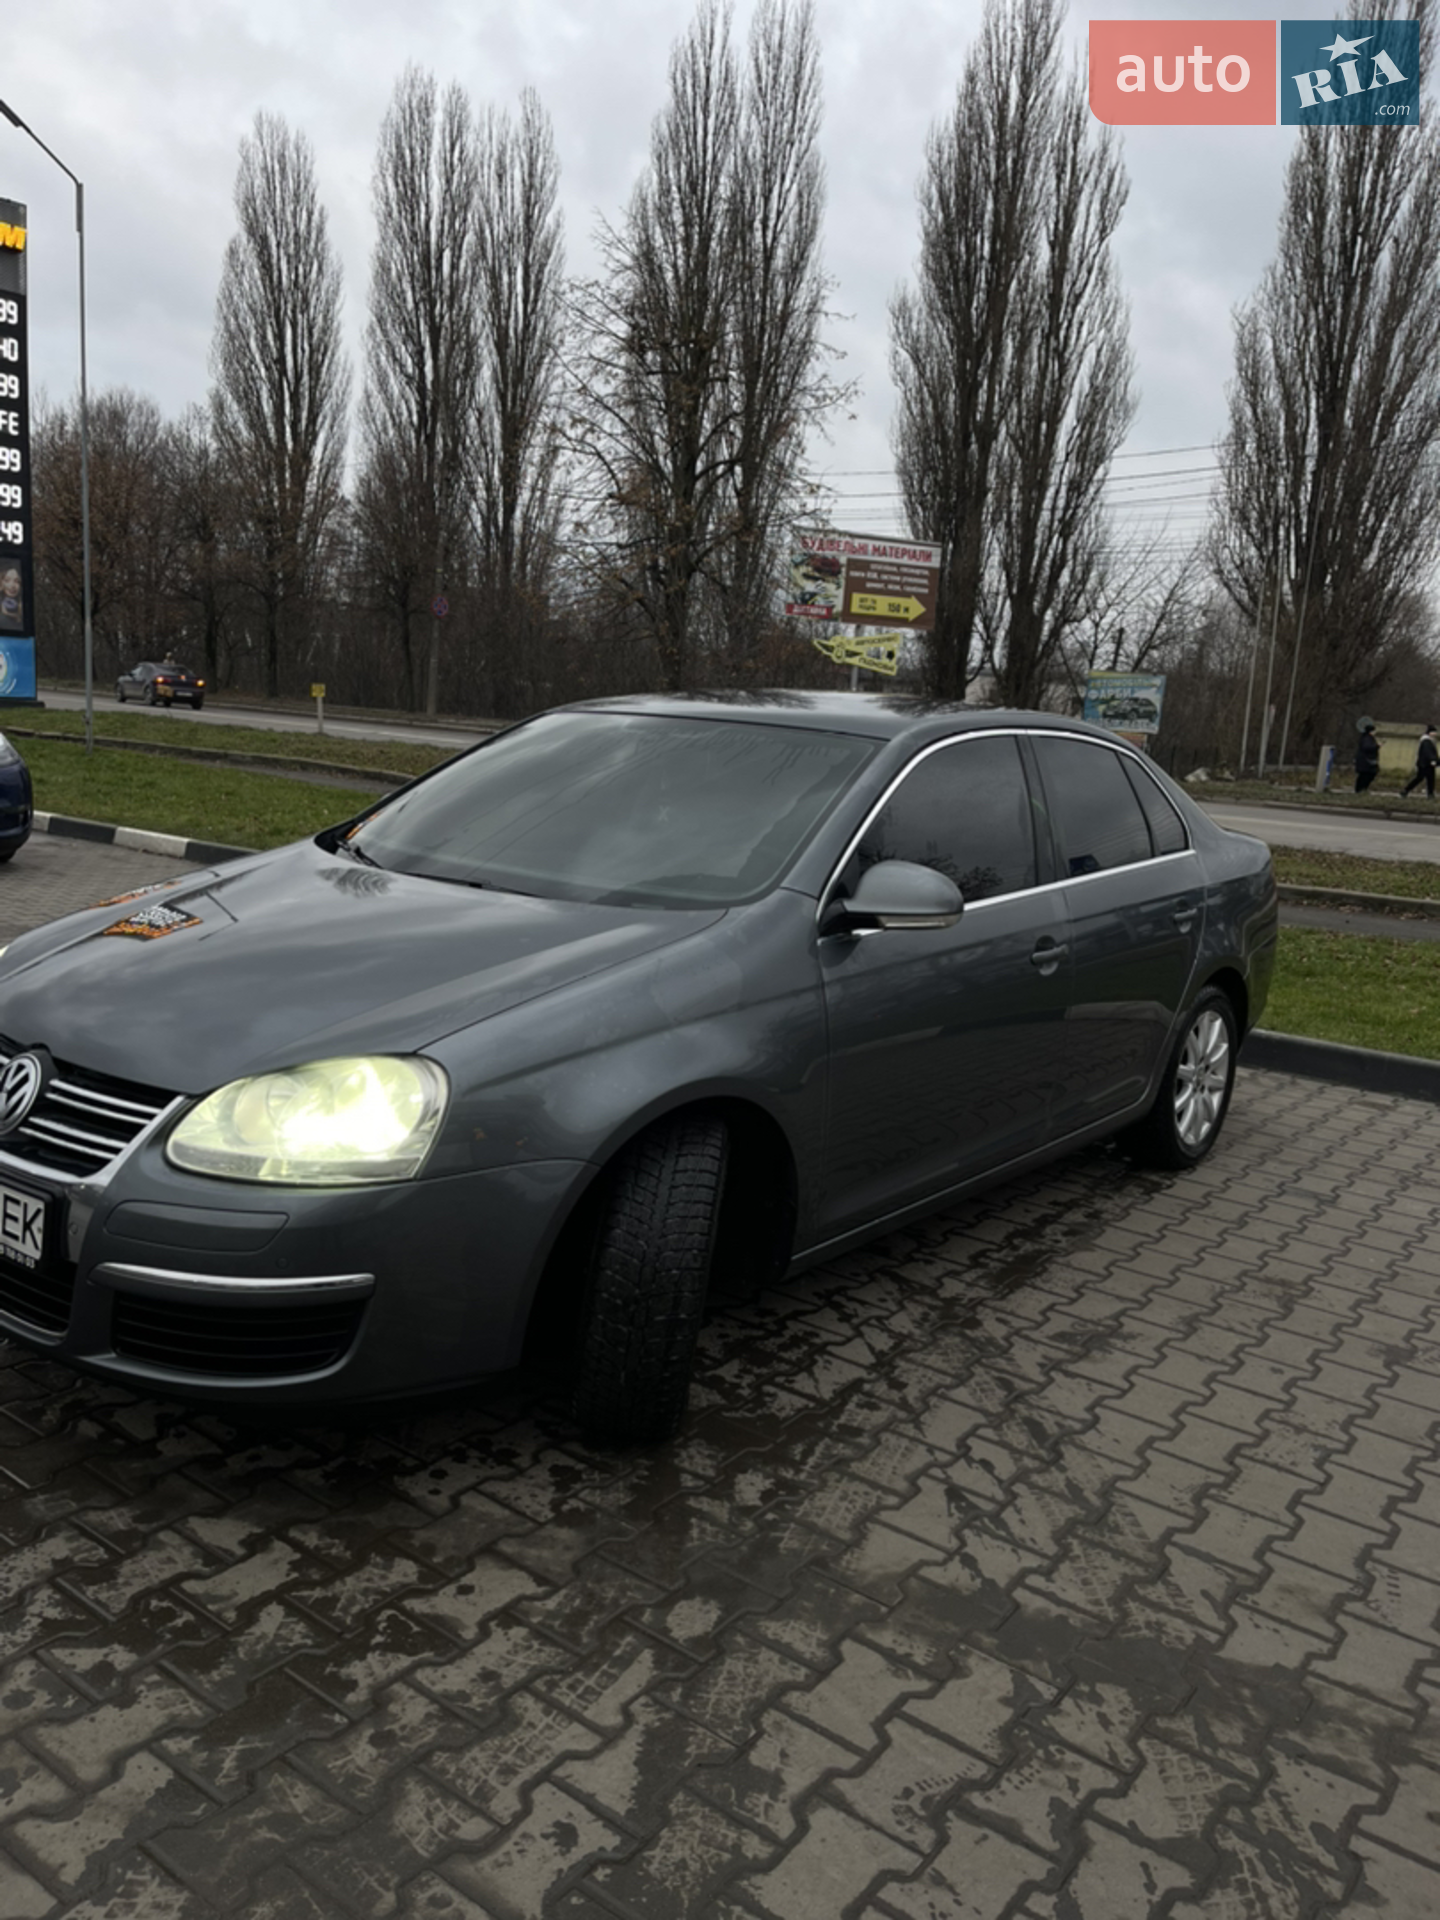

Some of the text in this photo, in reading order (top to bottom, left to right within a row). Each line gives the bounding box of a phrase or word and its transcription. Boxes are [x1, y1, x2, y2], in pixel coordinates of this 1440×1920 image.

[0, 446, 21, 472] 99
[0, 483, 22, 508] 99
[800, 536, 932, 563] БУДІВЕЛЬНІ МАТЕРІАЛИ
[887, 602, 901, 614] 150
